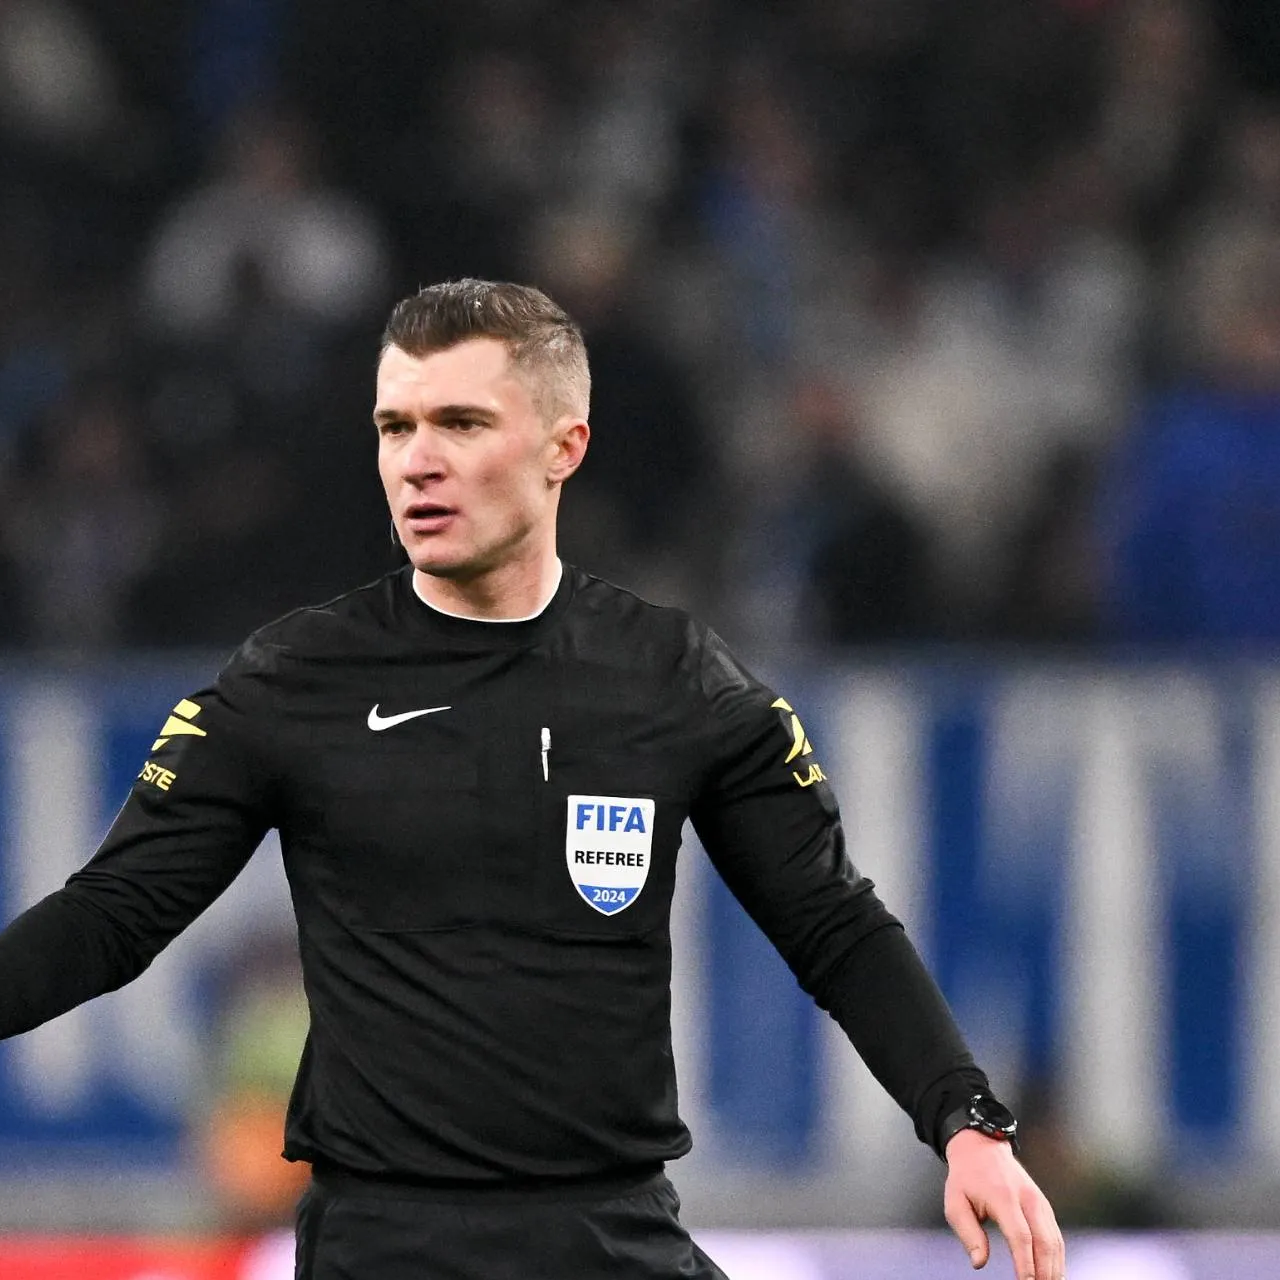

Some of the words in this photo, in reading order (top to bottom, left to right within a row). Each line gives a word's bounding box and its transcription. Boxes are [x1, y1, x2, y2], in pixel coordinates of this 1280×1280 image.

[576, 803, 646, 833] FIFA
[575, 850, 644, 867] REFEREE
[592, 889, 626, 903] 2024
